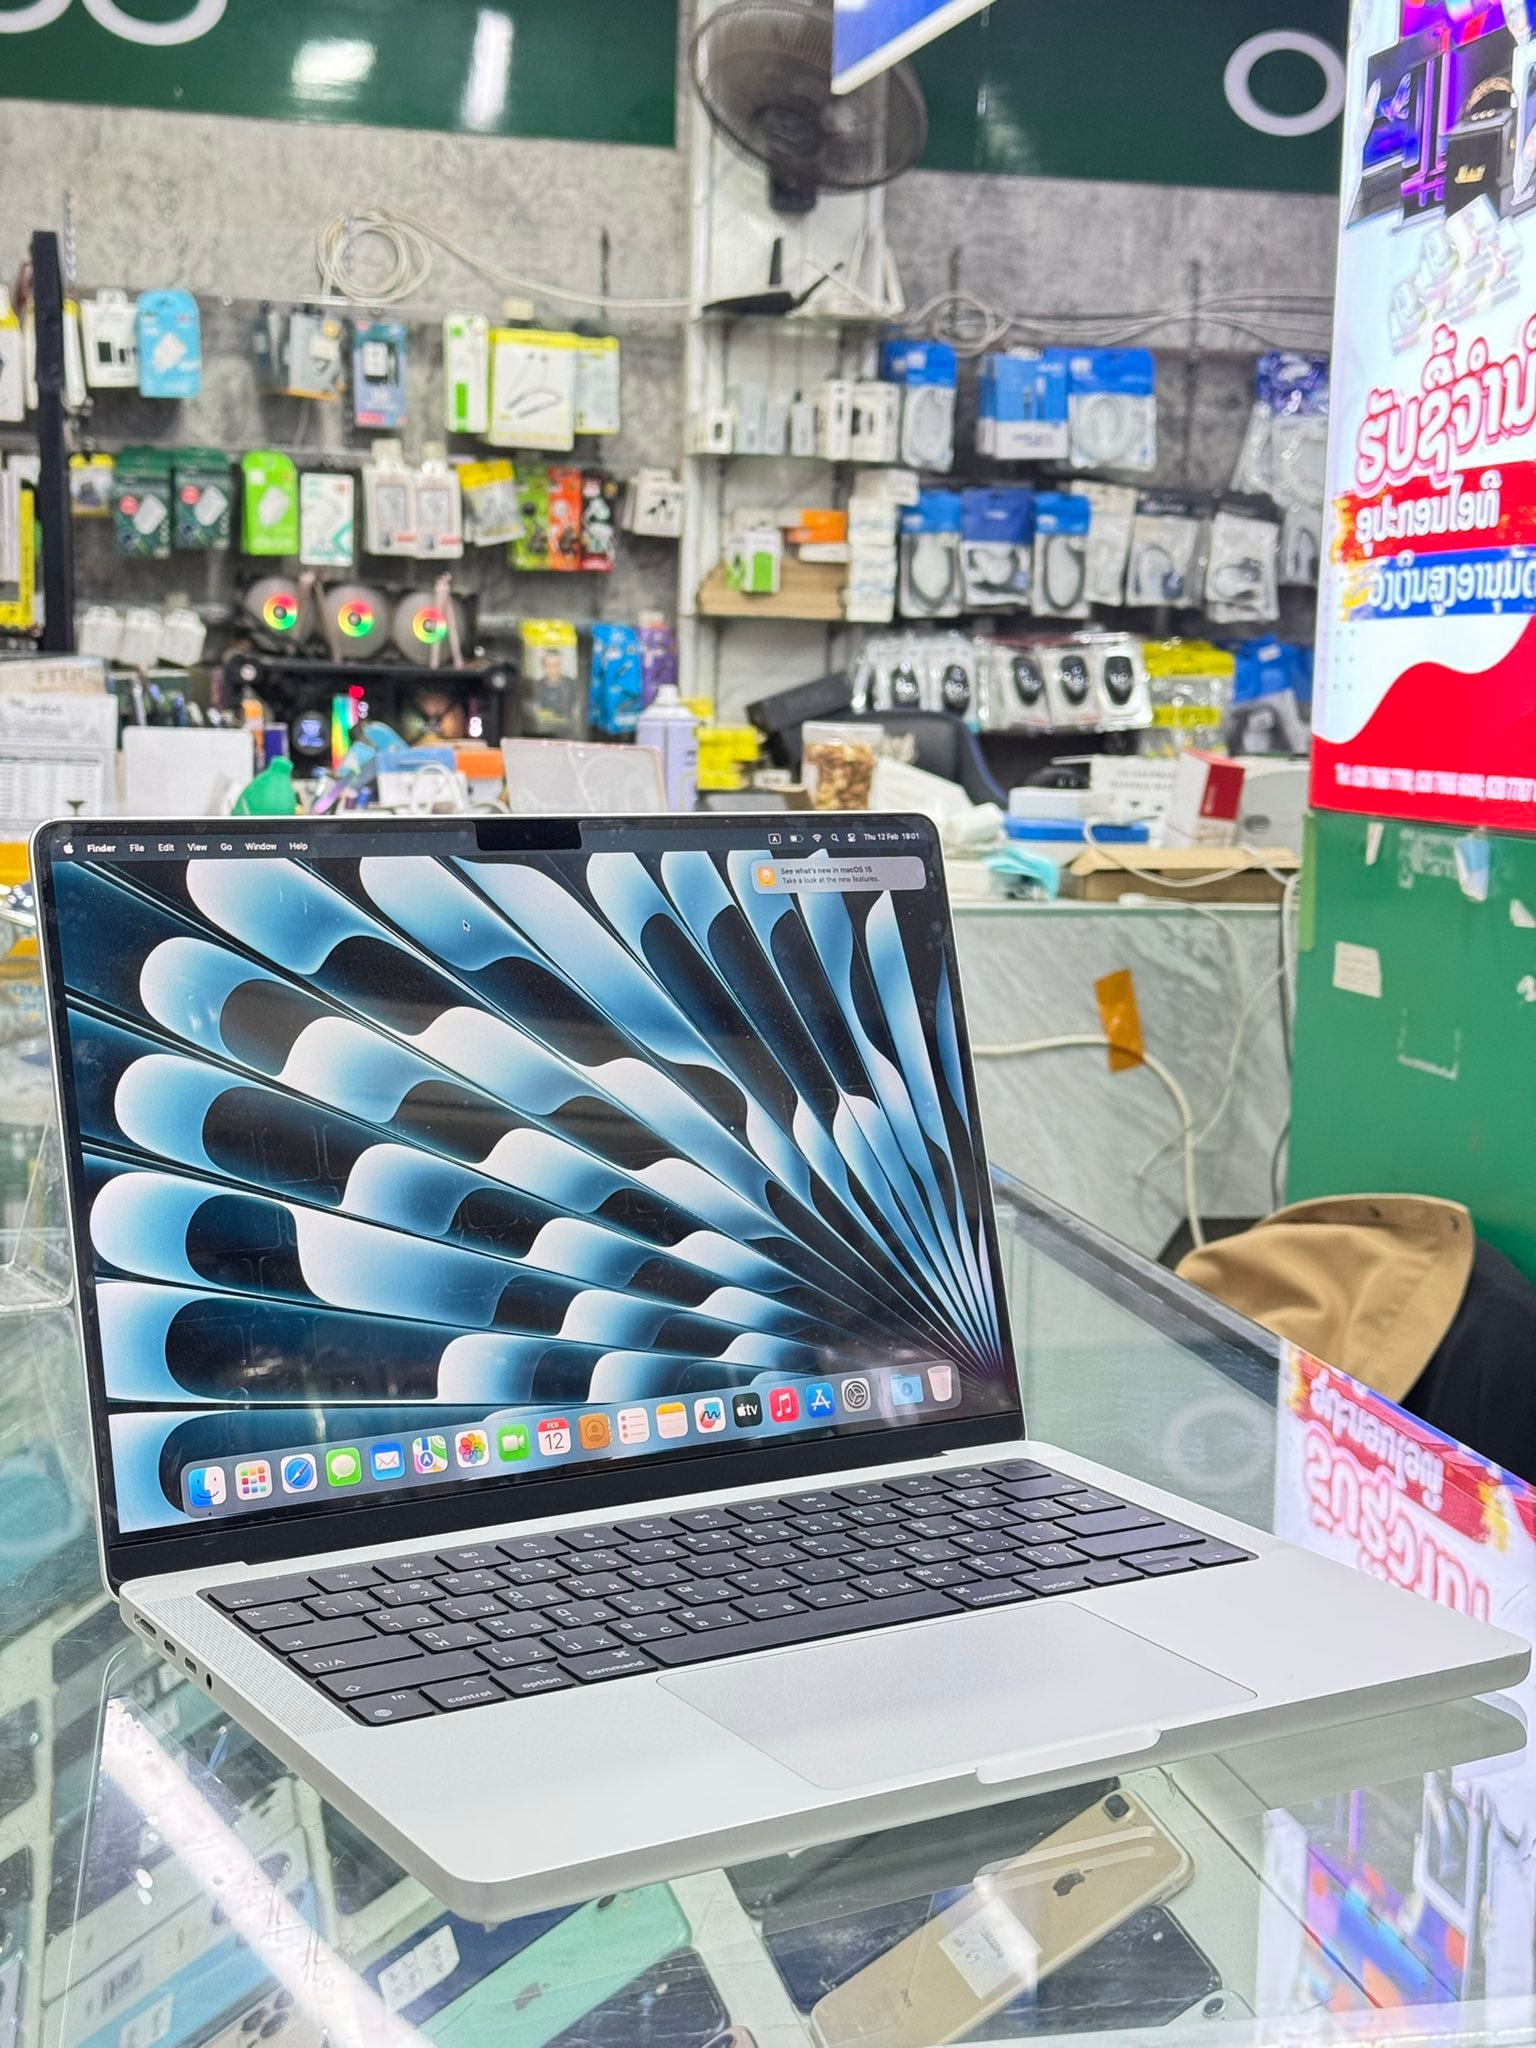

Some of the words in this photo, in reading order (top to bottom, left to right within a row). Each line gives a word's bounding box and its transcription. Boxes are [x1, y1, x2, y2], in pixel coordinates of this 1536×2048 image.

[886, 832, 899, 840] Feb
[87, 844, 116, 852] Finder
[130, 844, 144, 852] File
[158, 844, 175, 852] Edit
[187, 843, 208, 851] View
[220, 843, 232, 851] Go
[244, 842, 278, 851] Window
[289, 842, 308, 852] Help
[832, 866, 839, 874] in
[840, 866, 863, 874] macOS
[746, 1404, 758, 1416] tv
[545, 1432, 564, 1450] 12
[586, 1660, 645, 1676] command
[521, 1677, 562, 1689] option
[447, 1690, 492, 1704] control
